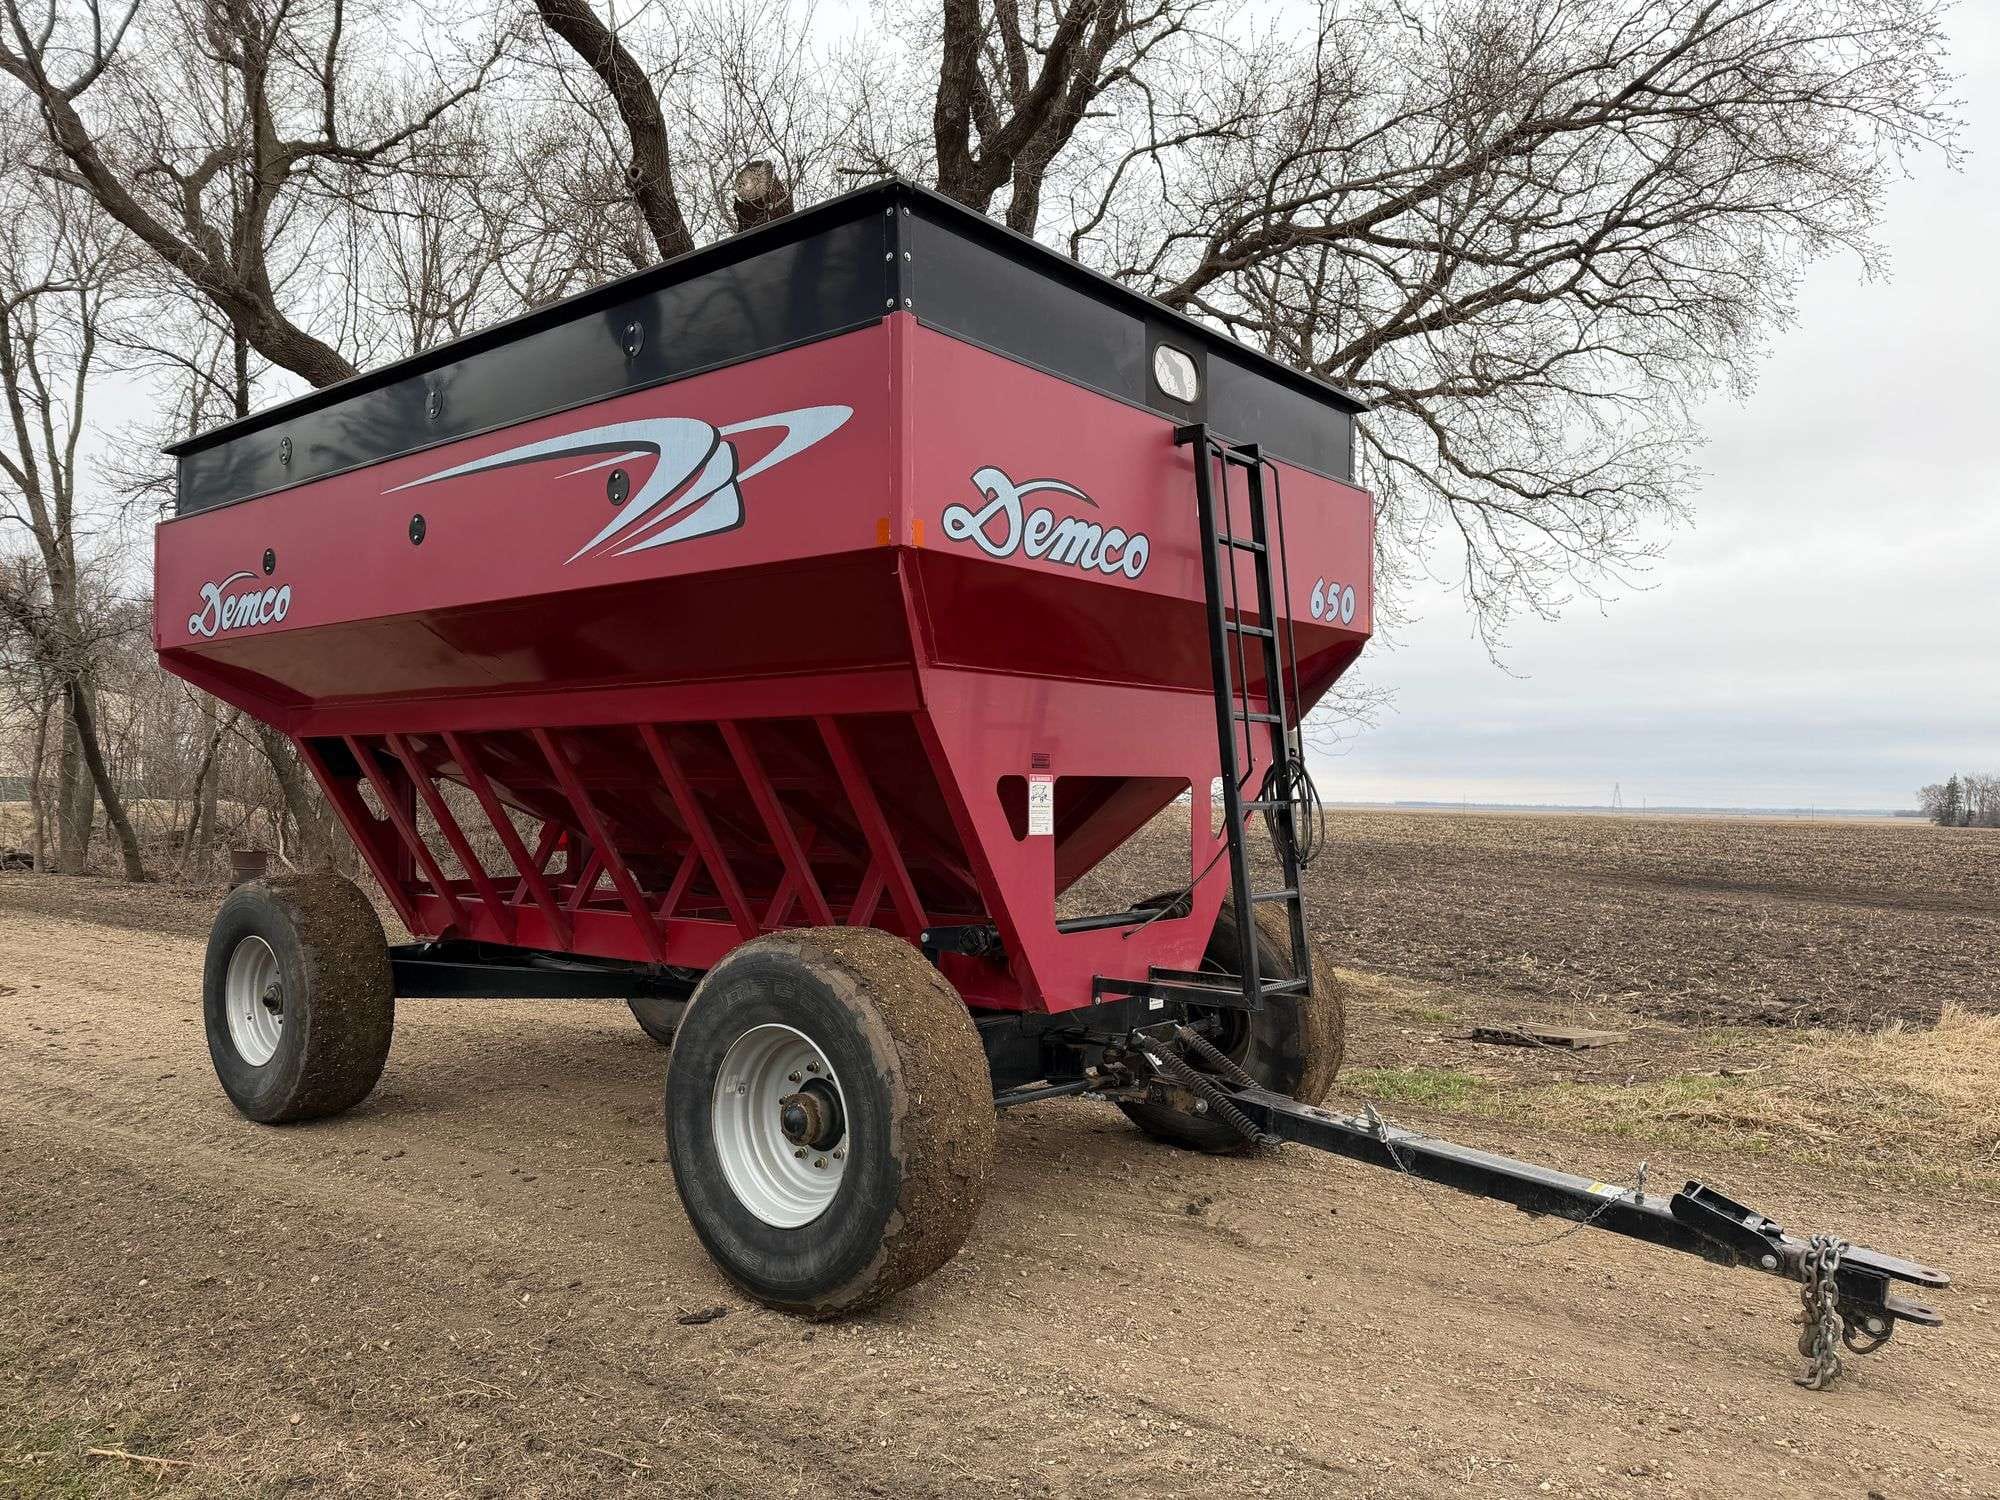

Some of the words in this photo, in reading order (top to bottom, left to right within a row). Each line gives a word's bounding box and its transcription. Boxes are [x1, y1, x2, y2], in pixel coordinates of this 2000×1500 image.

[942, 465, 1150, 579] Demco
[187, 571, 291, 637] Demco
[1310, 576, 1355, 625] 650
